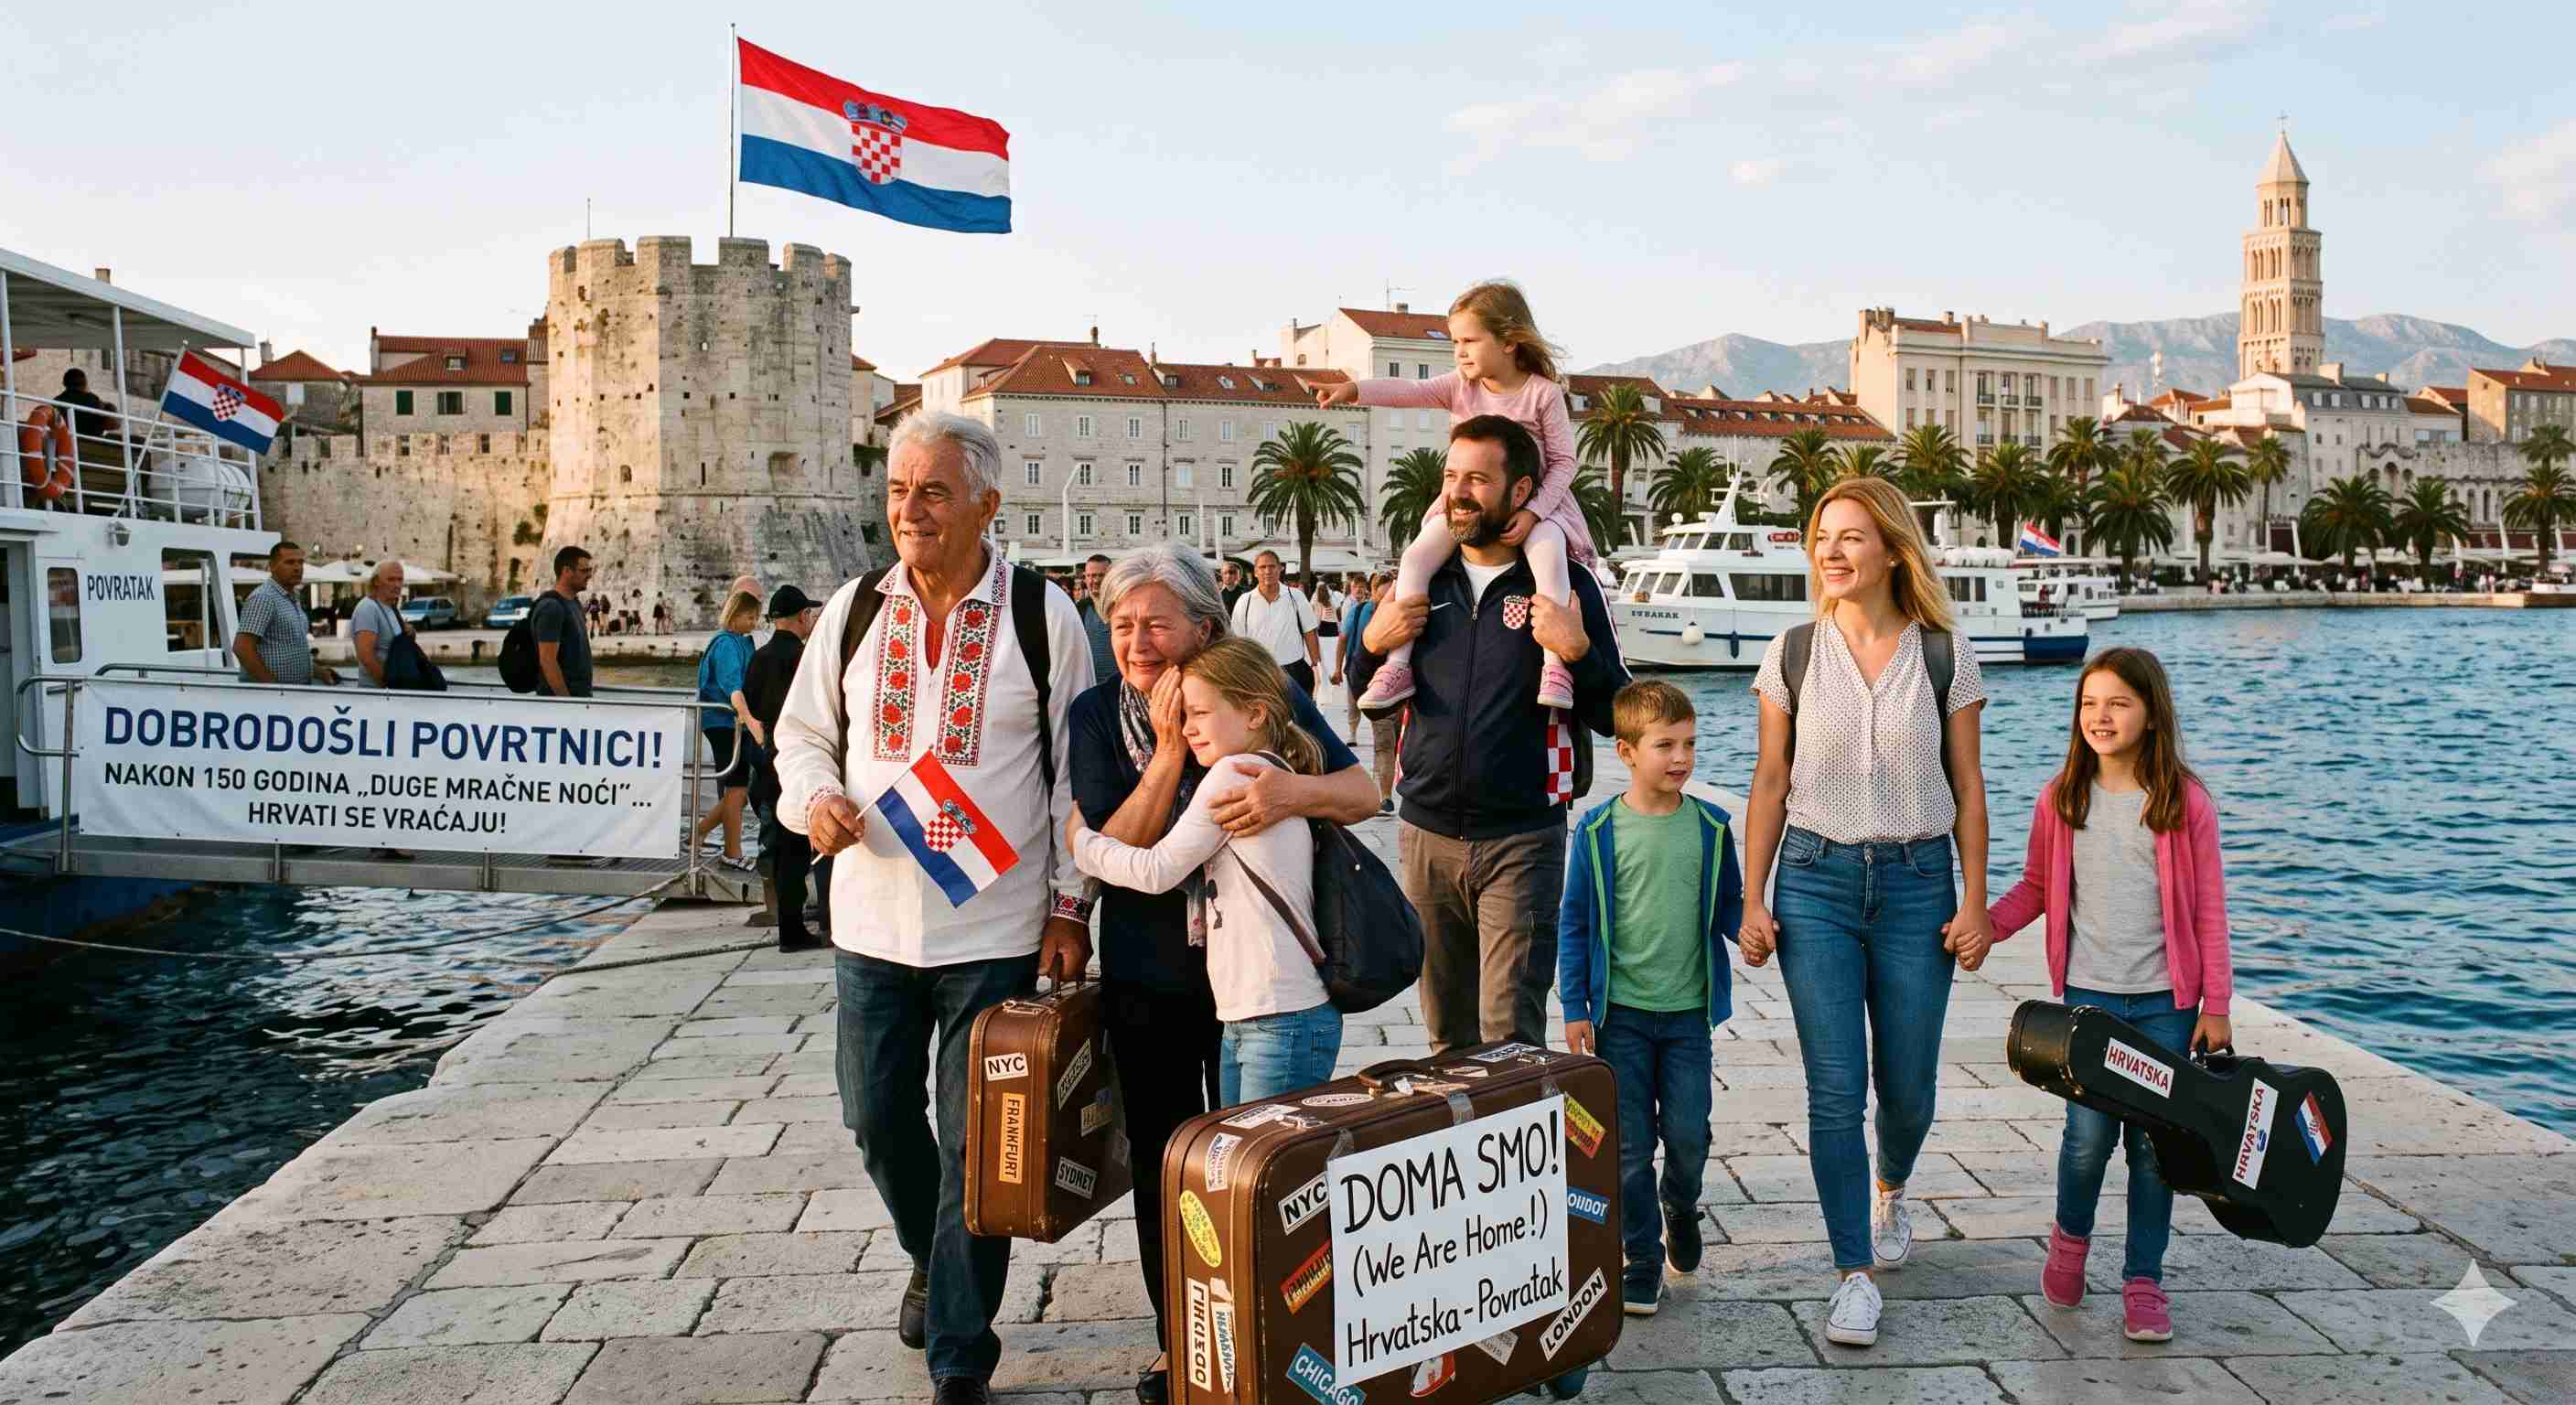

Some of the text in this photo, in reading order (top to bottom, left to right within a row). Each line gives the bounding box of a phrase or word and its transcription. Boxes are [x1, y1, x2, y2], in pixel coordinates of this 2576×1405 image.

[87, 574, 155, 601] POVRATAK
[104, 705, 663, 769] DOBRODOŠLI POVRTNICI!
[104, 762, 195, 788] NAKON
[204, 767, 246, 789] 150
[253, 769, 350, 795] GODINA
[445, 774, 552, 803] MRAČNE
[248, 801, 506, 834] HRVATI SE VRAĆAJU!
[987, 1056, 1025, 1075] NYC
[2108, 1046, 2168, 1090] HRVATSKA
[1004, 1099, 1021, 1179] FRANKFURT
[2236, 1087, 2266, 1180] HRVATSKA
[1340, 1146, 1465, 1234] DOMA
[1477, 1110, 1559, 1193] SMO!
[1283, 1181, 1327, 1225] NYC
[1353, 1242, 1405, 1297] (We
[1413, 1231, 1457, 1274] Are
[1465, 1188, 1548, 1257] Home!)
[1546, 1275, 1604, 1352] LONDON
